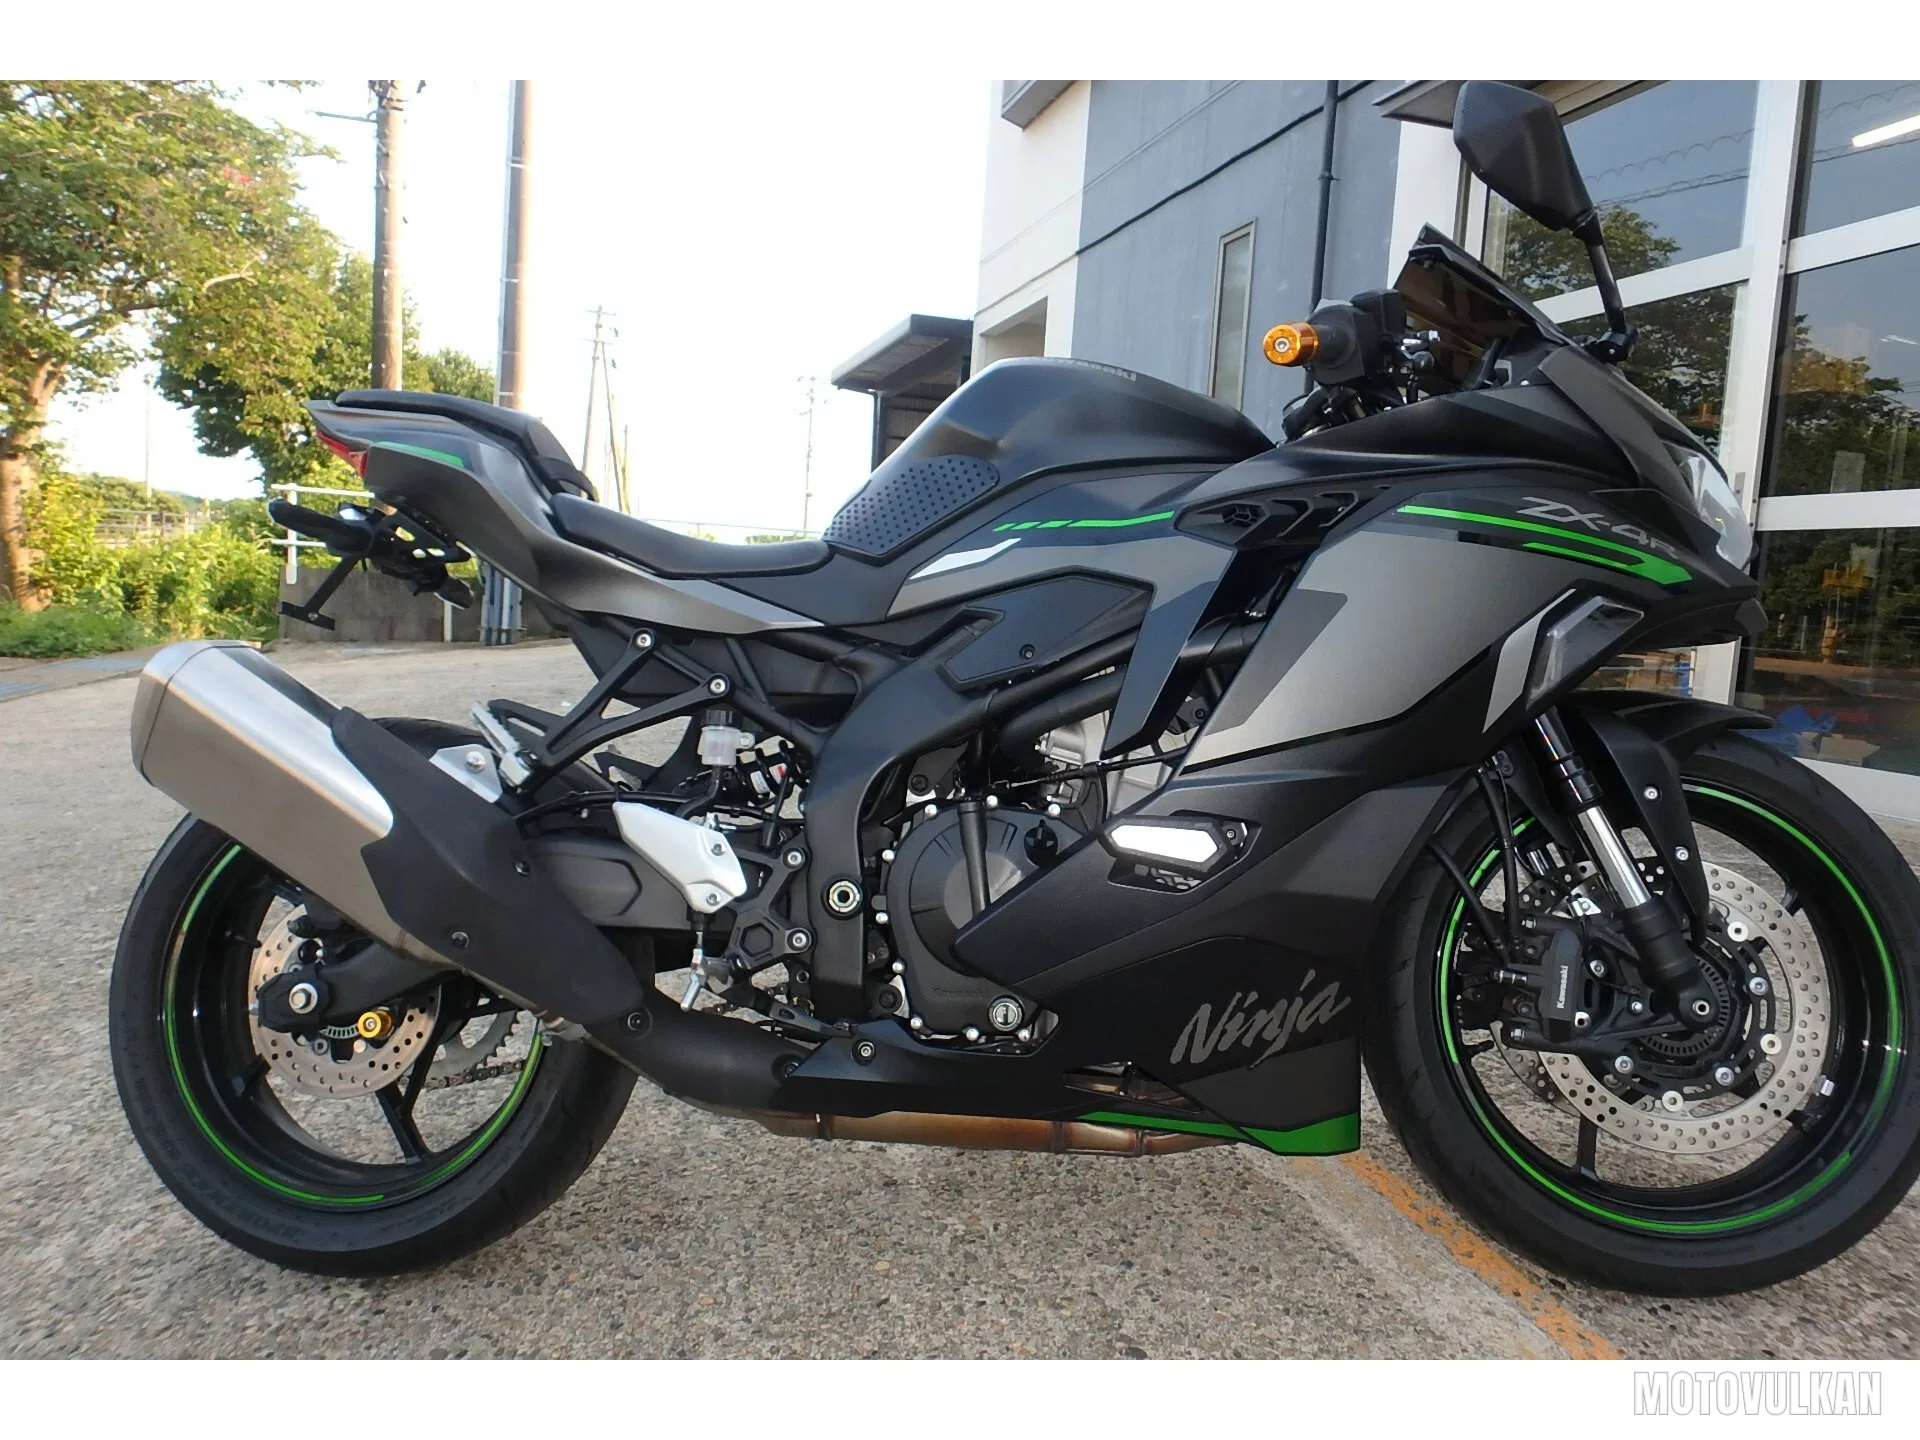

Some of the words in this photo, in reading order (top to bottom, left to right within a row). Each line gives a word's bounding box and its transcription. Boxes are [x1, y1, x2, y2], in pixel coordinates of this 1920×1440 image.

[1516, 496, 1679, 560] ZX-4R
[1556, 964, 1569, 1009] Kawasaki
[1169, 968, 1351, 1070] Ninja
